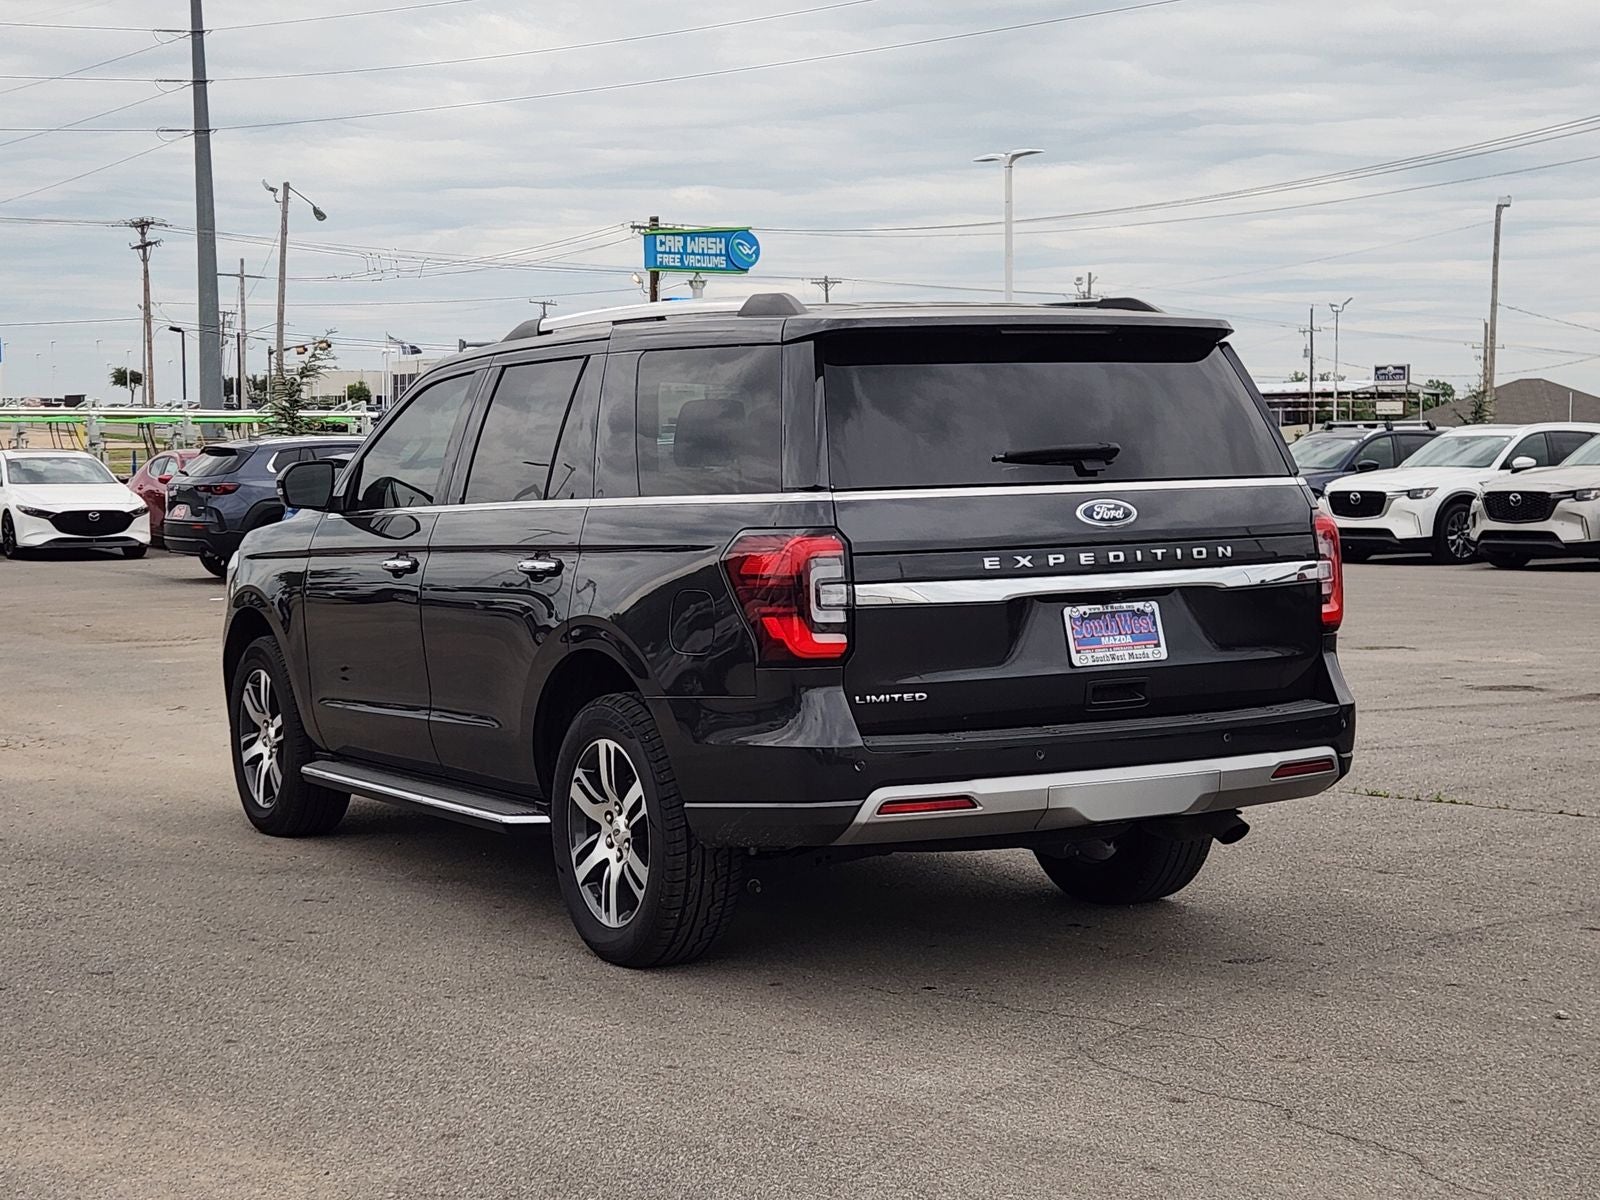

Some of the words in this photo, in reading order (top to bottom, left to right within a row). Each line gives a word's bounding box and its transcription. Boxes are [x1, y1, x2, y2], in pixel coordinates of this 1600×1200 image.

[656, 235, 683, 252] CAR
[686, 236, 726, 254] WASH
[656, 254, 681, 266] FREE
[683, 255, 727, 268] VACUUMS
[1092, 503, 1125, 520] Ford
[982, 544, 1234, 570] EXPEDITION
[1071, 612, 1156, 639] SouthWest
[1101, 635, 1133, 645] MAZDA
[1091, 653, 1127, 663] SouthWest
[1128, 651, 1150, 661] Mazda
[854, 692, 928, 704] LIMITED
